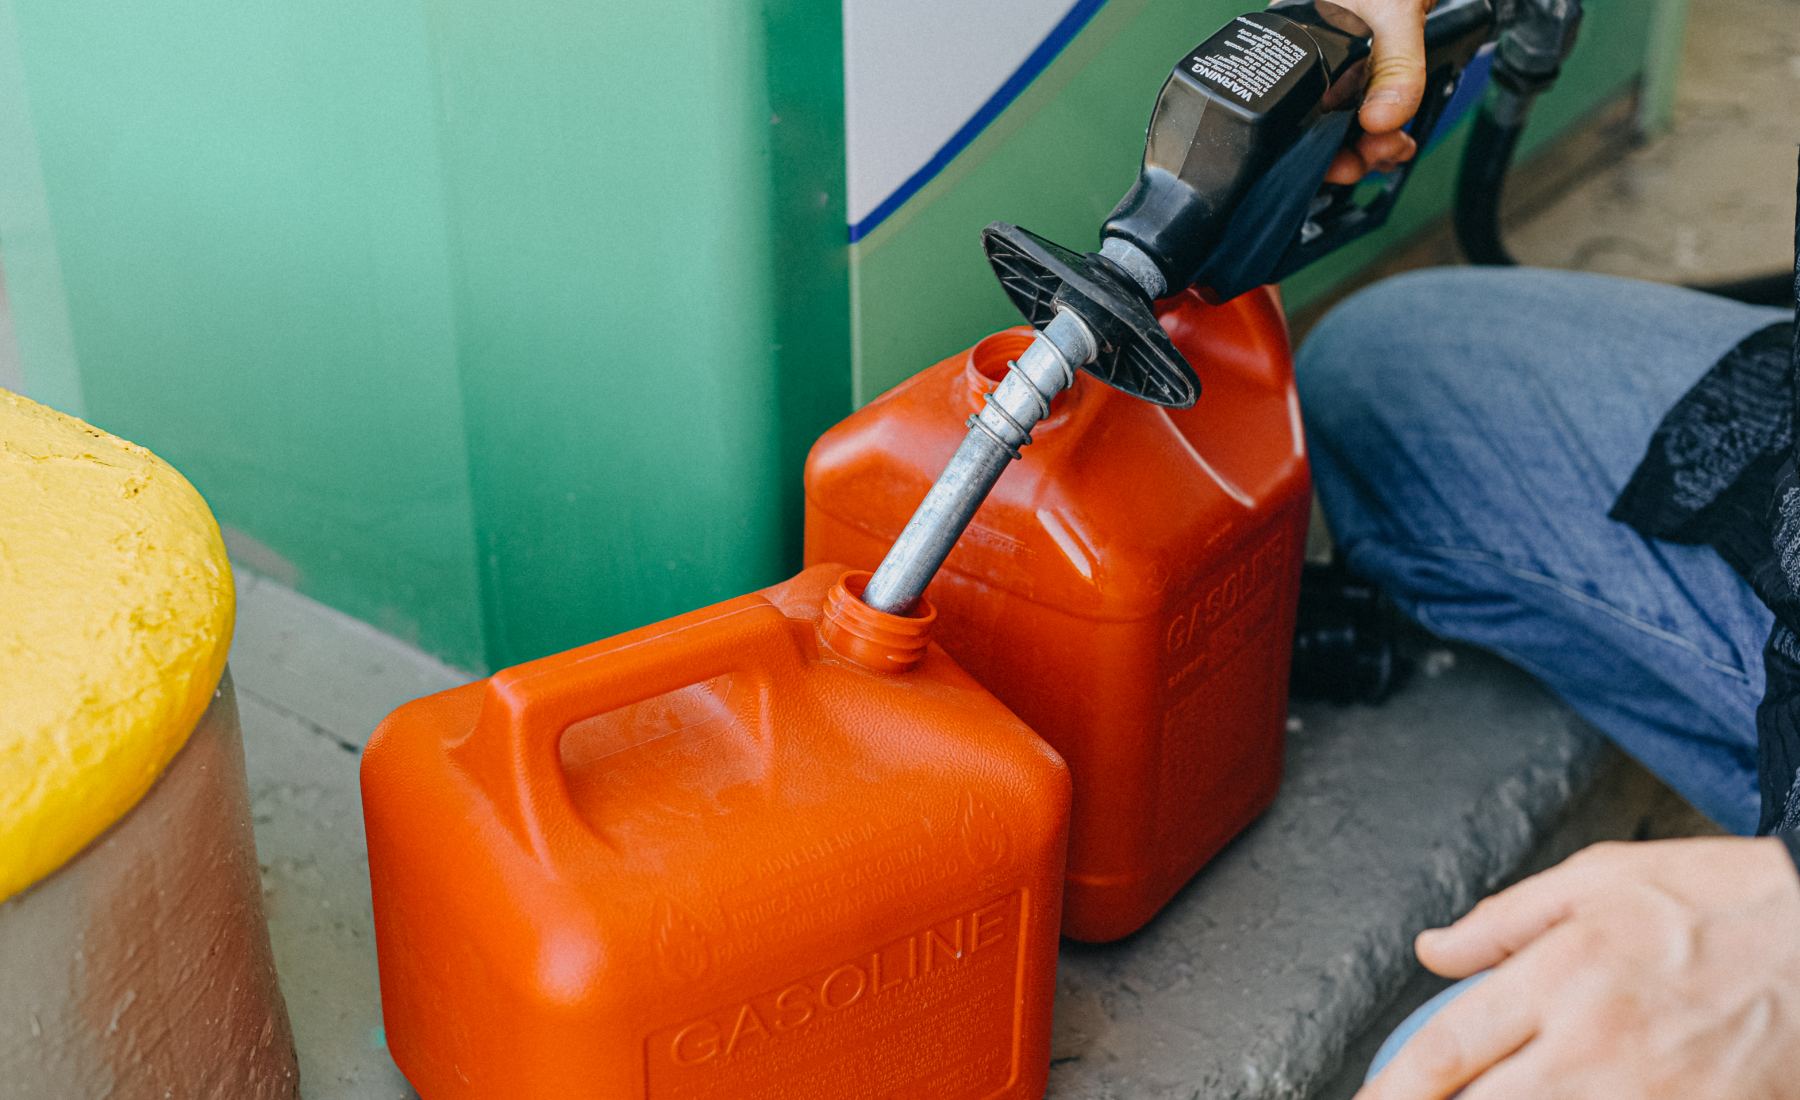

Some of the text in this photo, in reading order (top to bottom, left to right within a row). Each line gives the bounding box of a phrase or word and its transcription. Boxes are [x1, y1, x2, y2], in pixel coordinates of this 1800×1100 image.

[1262, 27, 1286, 41] posted
[1238, 28, 1299, 65] Licensed drivers only
[1272, 38, 1283, 48] top
[1281, 44, 1293, 54] not
[1290, 43, 1308, 57] Refer
[1243, 49, 1267, 64] remove
[1254, 47, 1280, 66] smoking
[1292, 52, 1303, 61] Do
[1265, 61, 1277, 70] not
[1275, 68, 1285, 76] do
[1279, 64, 1290, 73] No
[1191, 63, 1253, 102] WARNING
[1193, 56, 1264, 98] Improper use may cause
[1231, 67, 1263, 90] hazardous
[1254, 75, 1273, 89] Avoid
[671, 905, 1005, 1066] GASOLINE
